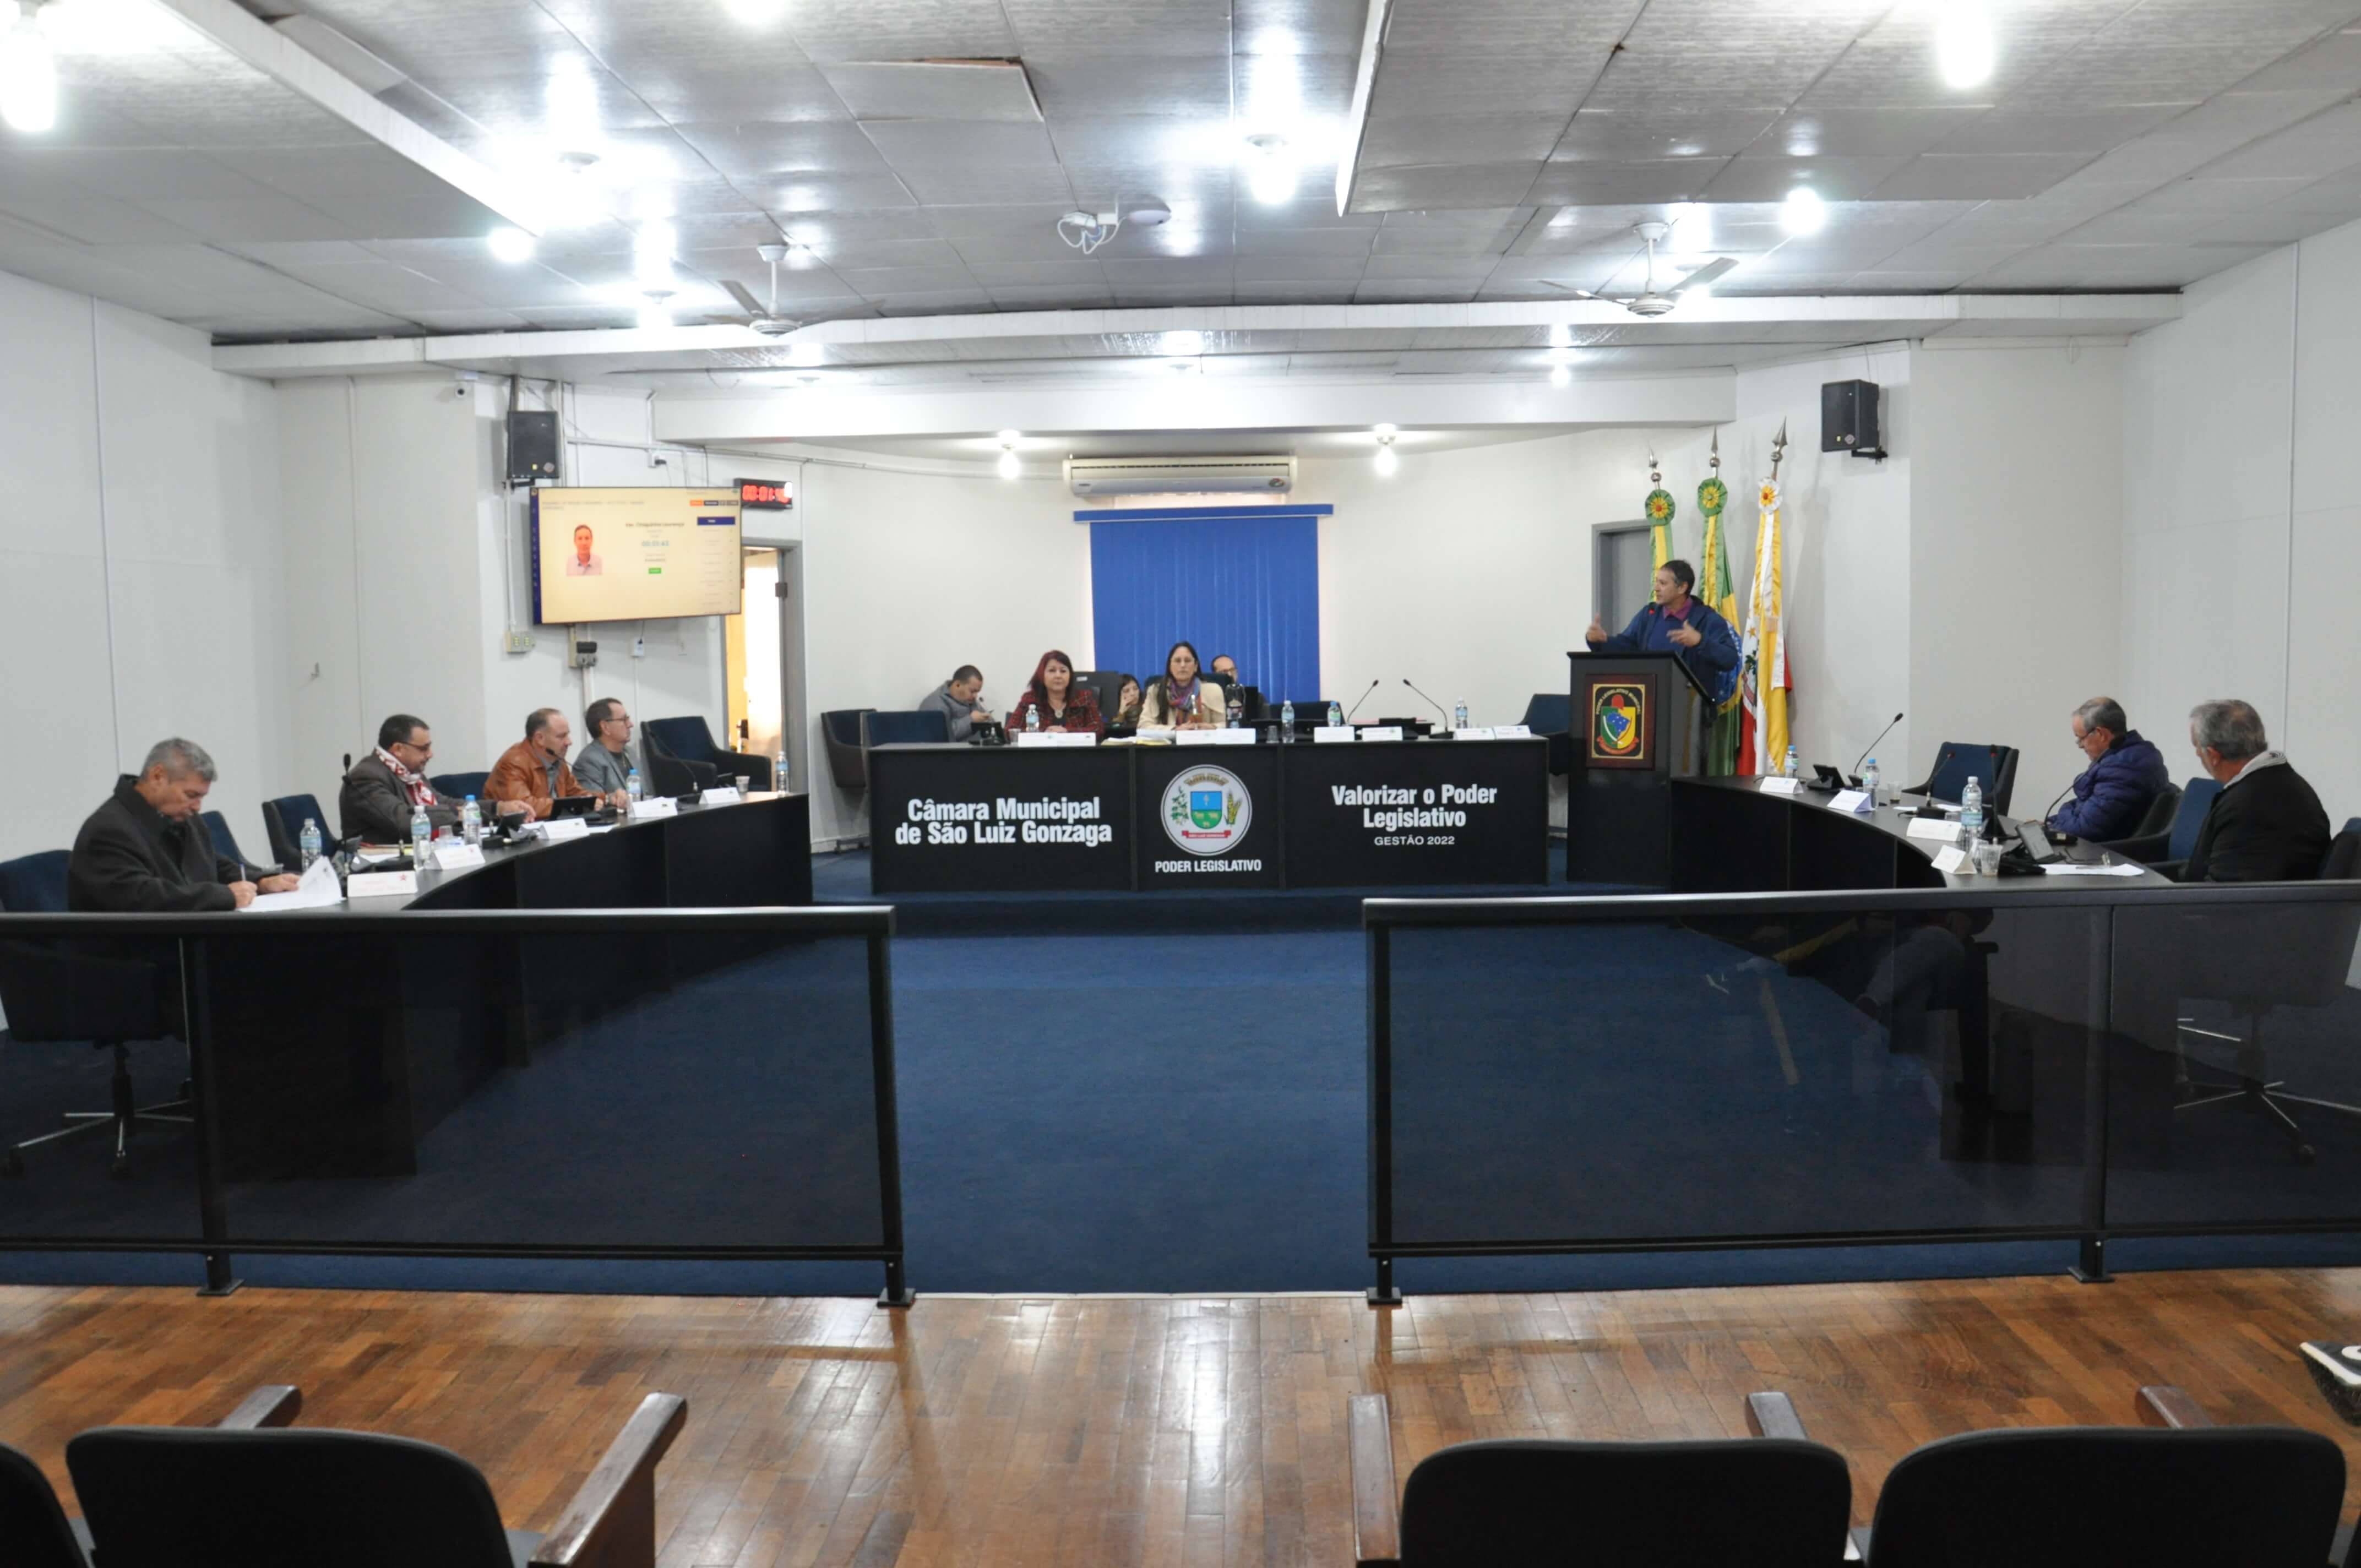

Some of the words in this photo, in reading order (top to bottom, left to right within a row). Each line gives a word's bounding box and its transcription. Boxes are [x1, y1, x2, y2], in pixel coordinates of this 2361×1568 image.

[1331, 785, 1417, 805] Valorizar
[1423, 788, 1435, 804] o
[1441, 783, 1497, 804] Poder
[908, 798, 989, 821] Câmara
[996, 797, 1100, 824] Municipal
[1363, 807, 1466, 832] Legislativo
[895, 822, 921, 845] de
[927, 821, 967, 845] São
[974, 820, 1016, 843] Luiz
[1021, 820, 1112, 847] Gonzaga
[1374, 835, 1424, 846] GESTÃO
[1427, 836, 1455, 845] 2022
[1155, 861, 1192, 873] PODER
[1194, 859, 1261, 872] LEGISLATIVO
